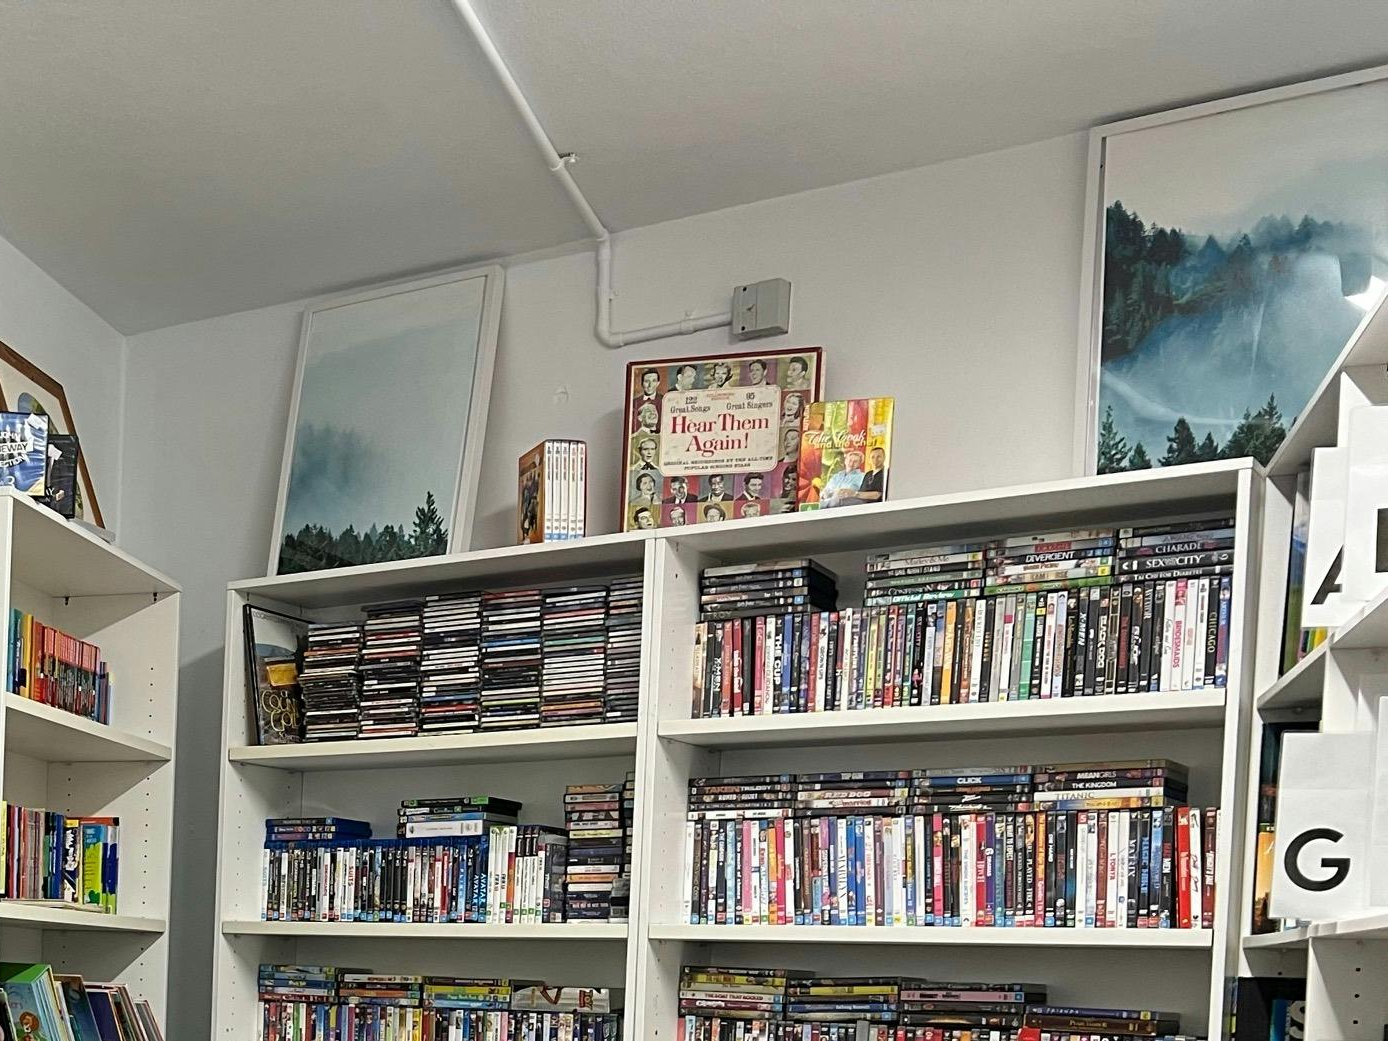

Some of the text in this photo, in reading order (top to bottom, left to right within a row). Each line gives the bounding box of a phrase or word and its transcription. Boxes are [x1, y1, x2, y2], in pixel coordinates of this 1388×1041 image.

[691, 404, 711, 412] Songs
[726, 401, 773, 410] Great Singers
[671, 412, 769, 434] Hear Them
[685, 432, 749, 458] Again!
[1025, 551, 1075, 563] DIVERGENT
[1155, 543, 1203, 553] CHARADE
[1146, 555, 1201, 568] SEX CITY
[1078, 613, 1086, 646] X-MEN
[1207, 612, 1217, 653] CHICAGO
[1173, 620, 1183, 668] BRIDESMAIDS
[773, 634, 783, 684] THE CUP
[1097, 648, 1106, 669] DOG
[714, 657, 722, 691] X-MEN
[1054, 792, 1095, 800] TITANIC
[1128, 839, 1136, 877] MATRIX
[1141, 837, 1149, 865] MAGIC
[1284, 828, 1351, 892] G
[977, 860, 985, 883] HITCH
[1163, 858, 1171, 873] MEN
[479, 873, 487, 904] AVATAR
